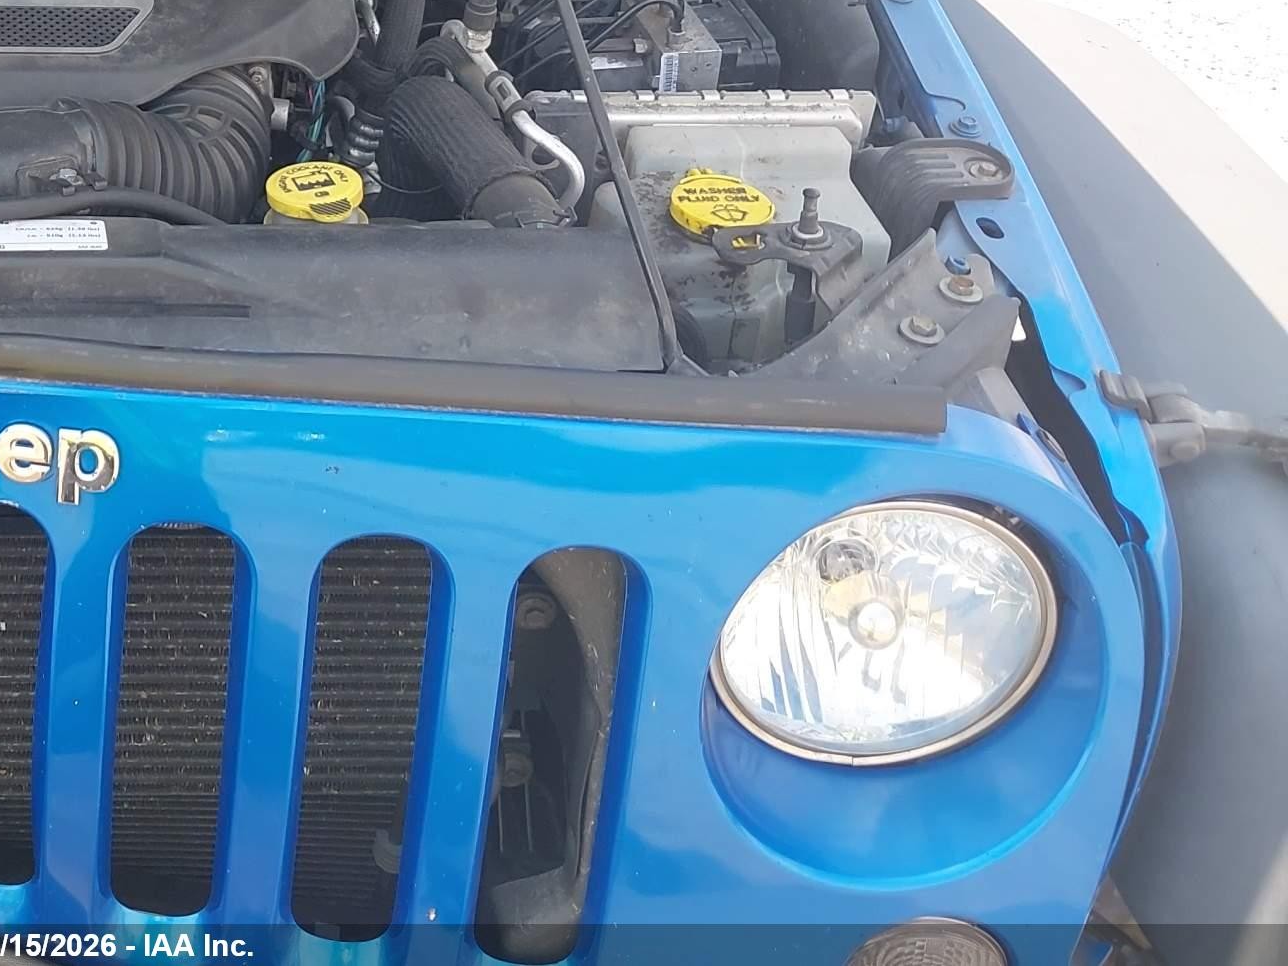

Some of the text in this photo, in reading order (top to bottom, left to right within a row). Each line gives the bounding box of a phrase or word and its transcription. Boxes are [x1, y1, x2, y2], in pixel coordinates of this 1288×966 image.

[286, 165, 333, 175] COOLANT
[334, 169, 349, 183] ONLY
[683, 187, 747, 195] WASHER
[678, 194, 760, 203] FLUID ONLY
